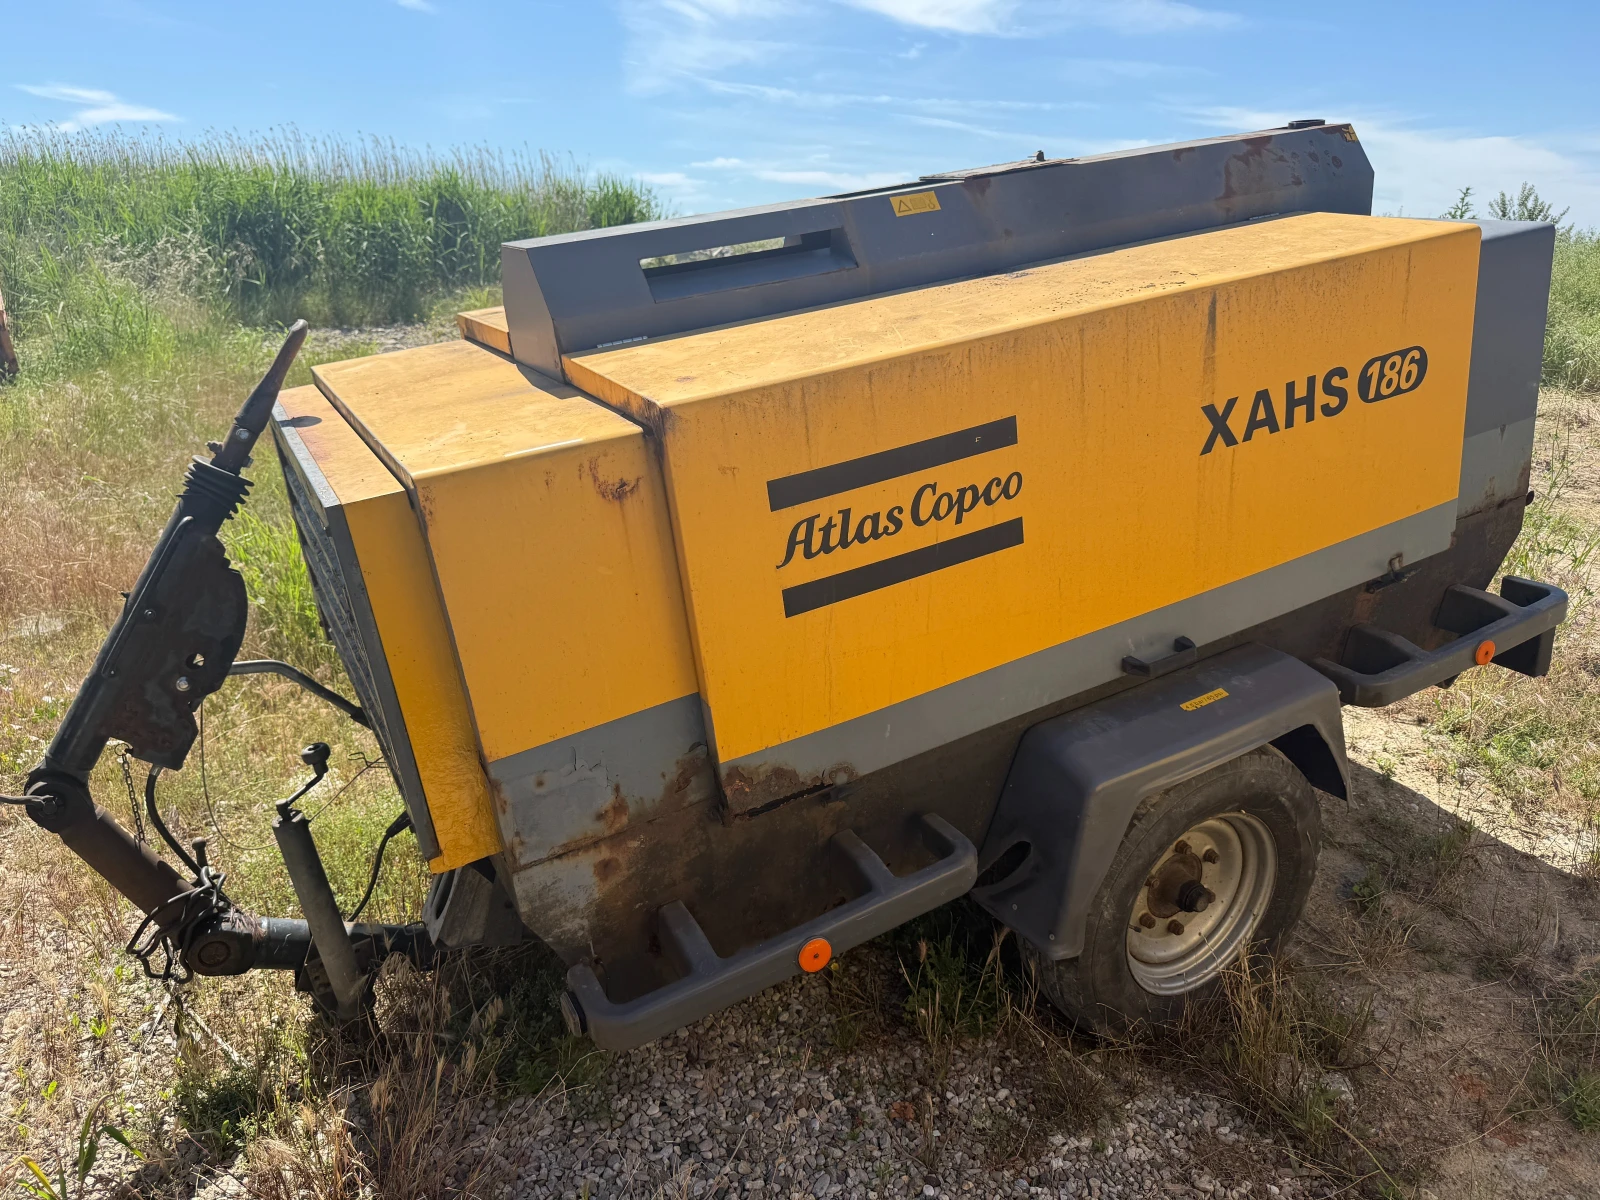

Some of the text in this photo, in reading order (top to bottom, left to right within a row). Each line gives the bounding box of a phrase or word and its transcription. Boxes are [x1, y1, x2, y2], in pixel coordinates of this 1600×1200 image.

[1199, 349, 1421, 456] XAHS 186
[775, 471, 1023, 570] Atlas Copco
